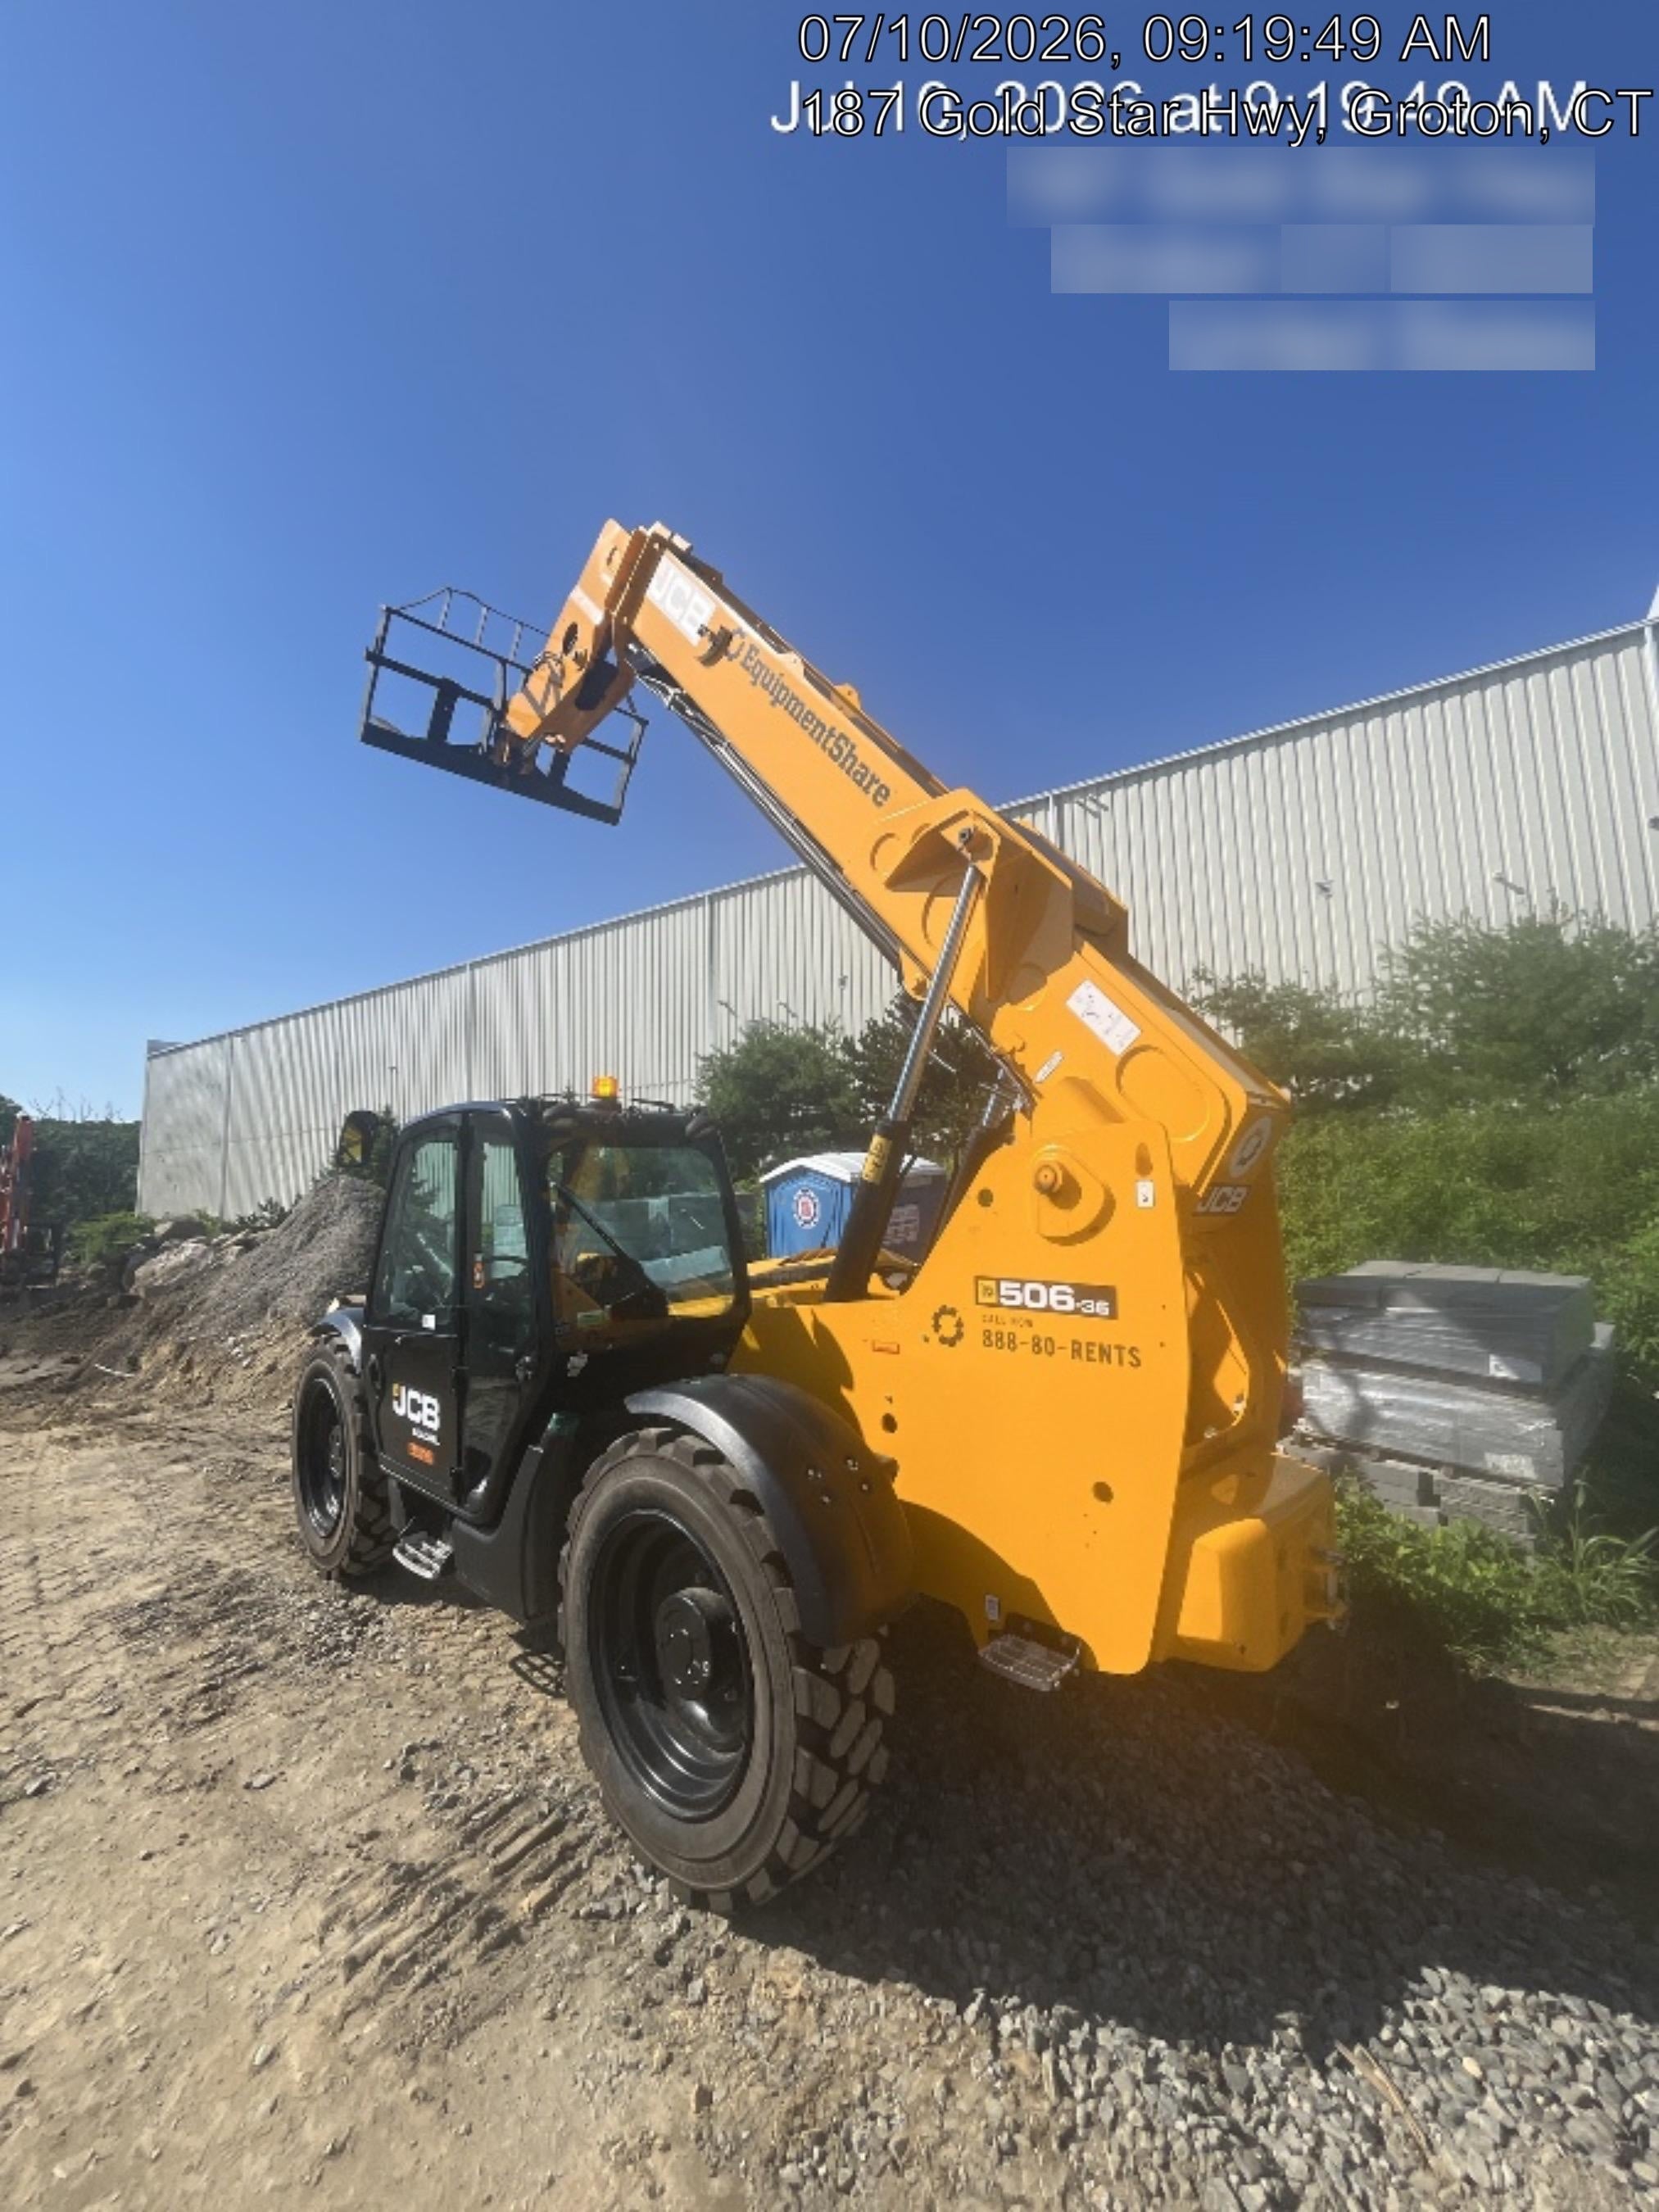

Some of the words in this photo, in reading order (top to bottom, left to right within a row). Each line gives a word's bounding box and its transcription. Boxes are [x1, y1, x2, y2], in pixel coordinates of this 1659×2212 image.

[646, 568, 710, 638] JCB
[741, 644, 891, 808] EquipmentShare
[1195, 1185, 1248, 1213] JCB
[982, 1329, 1141, 1369] 888-80-RENTS
[392, 1383, 441, 1431] JCB
